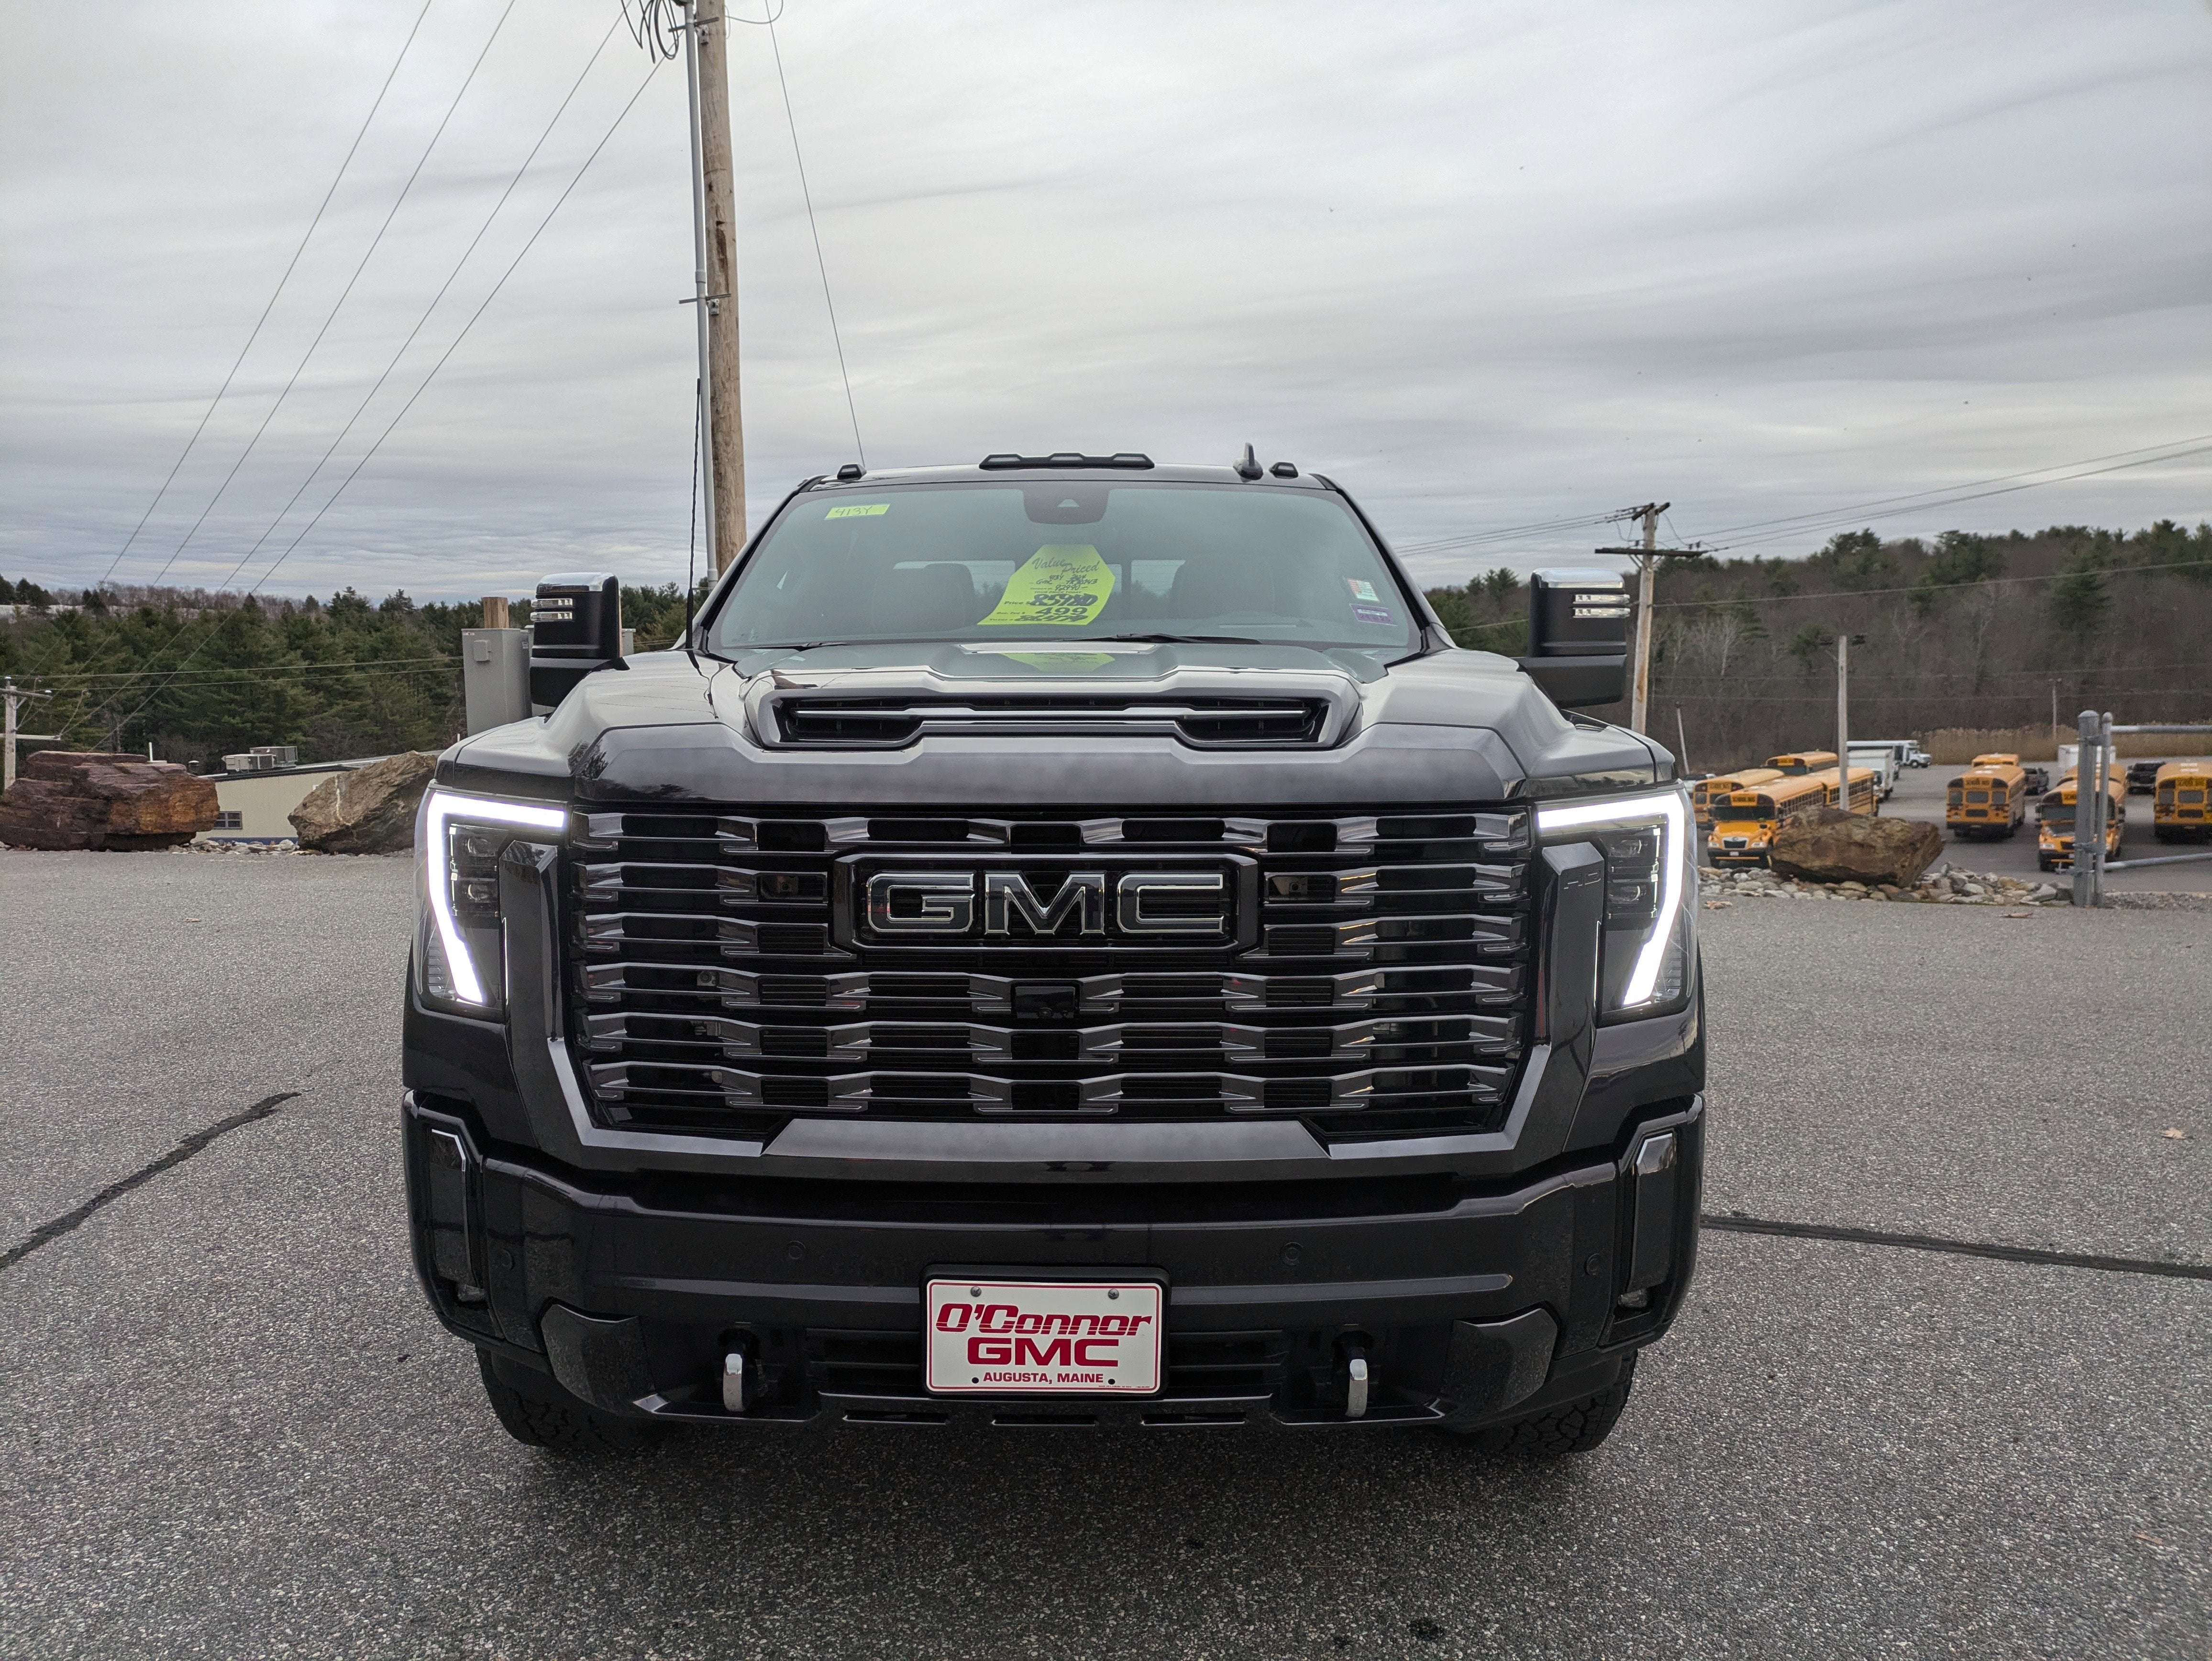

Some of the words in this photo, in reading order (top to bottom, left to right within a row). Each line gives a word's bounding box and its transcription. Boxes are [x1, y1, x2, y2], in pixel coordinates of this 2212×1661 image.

[835, 506, 873, 516] 413Y
[1032, 556, 1067, 570] Value
[1062, 560, 1100, 575] Priced
[866, 870, 1224, 936] GMC
[936, 1303, 1152, 1336] O'Connor
[967, 1337, 1119, 1367] GMC
[983, 1372, 1052, 1385] AUGUSTA,
[1057, 1373, 1104, 1383] MAINE
